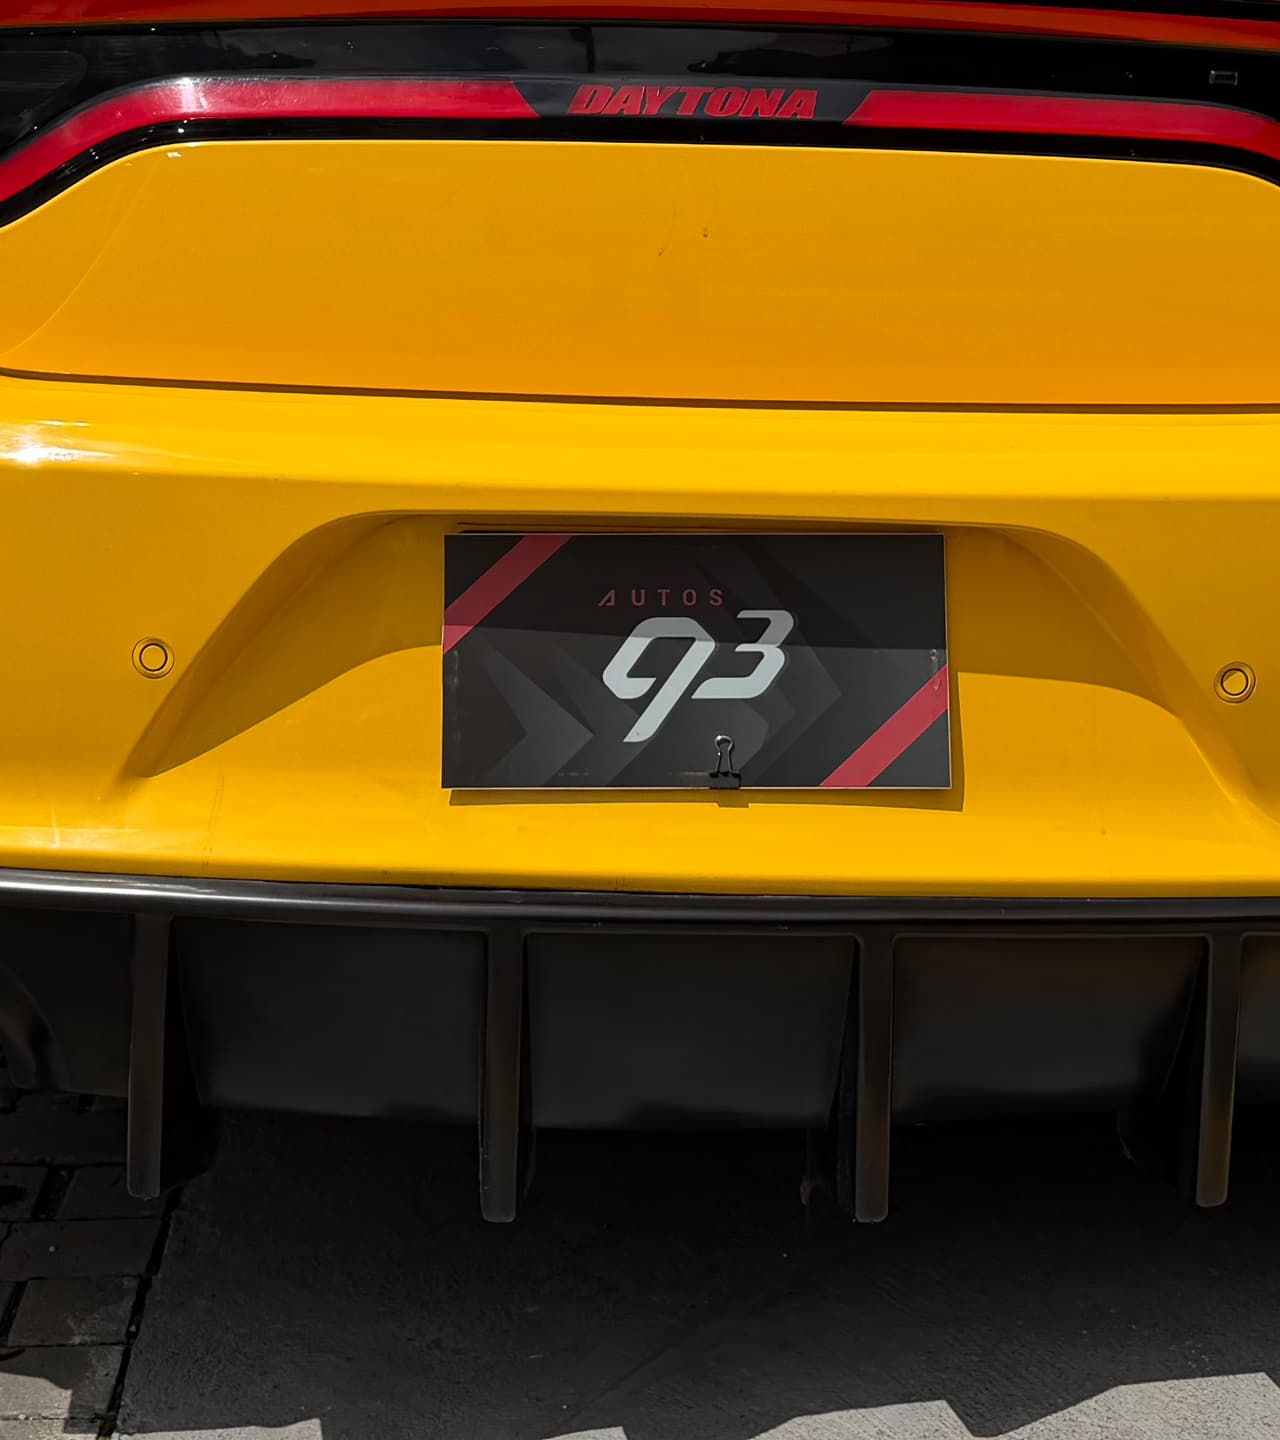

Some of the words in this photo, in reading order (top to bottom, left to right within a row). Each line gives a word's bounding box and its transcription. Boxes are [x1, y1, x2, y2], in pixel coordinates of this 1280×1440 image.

[566, 83, 818, 120] DAYTONA
[597, 588, 724, 607] AUTOS
[601, 609, 797, 743] 93
